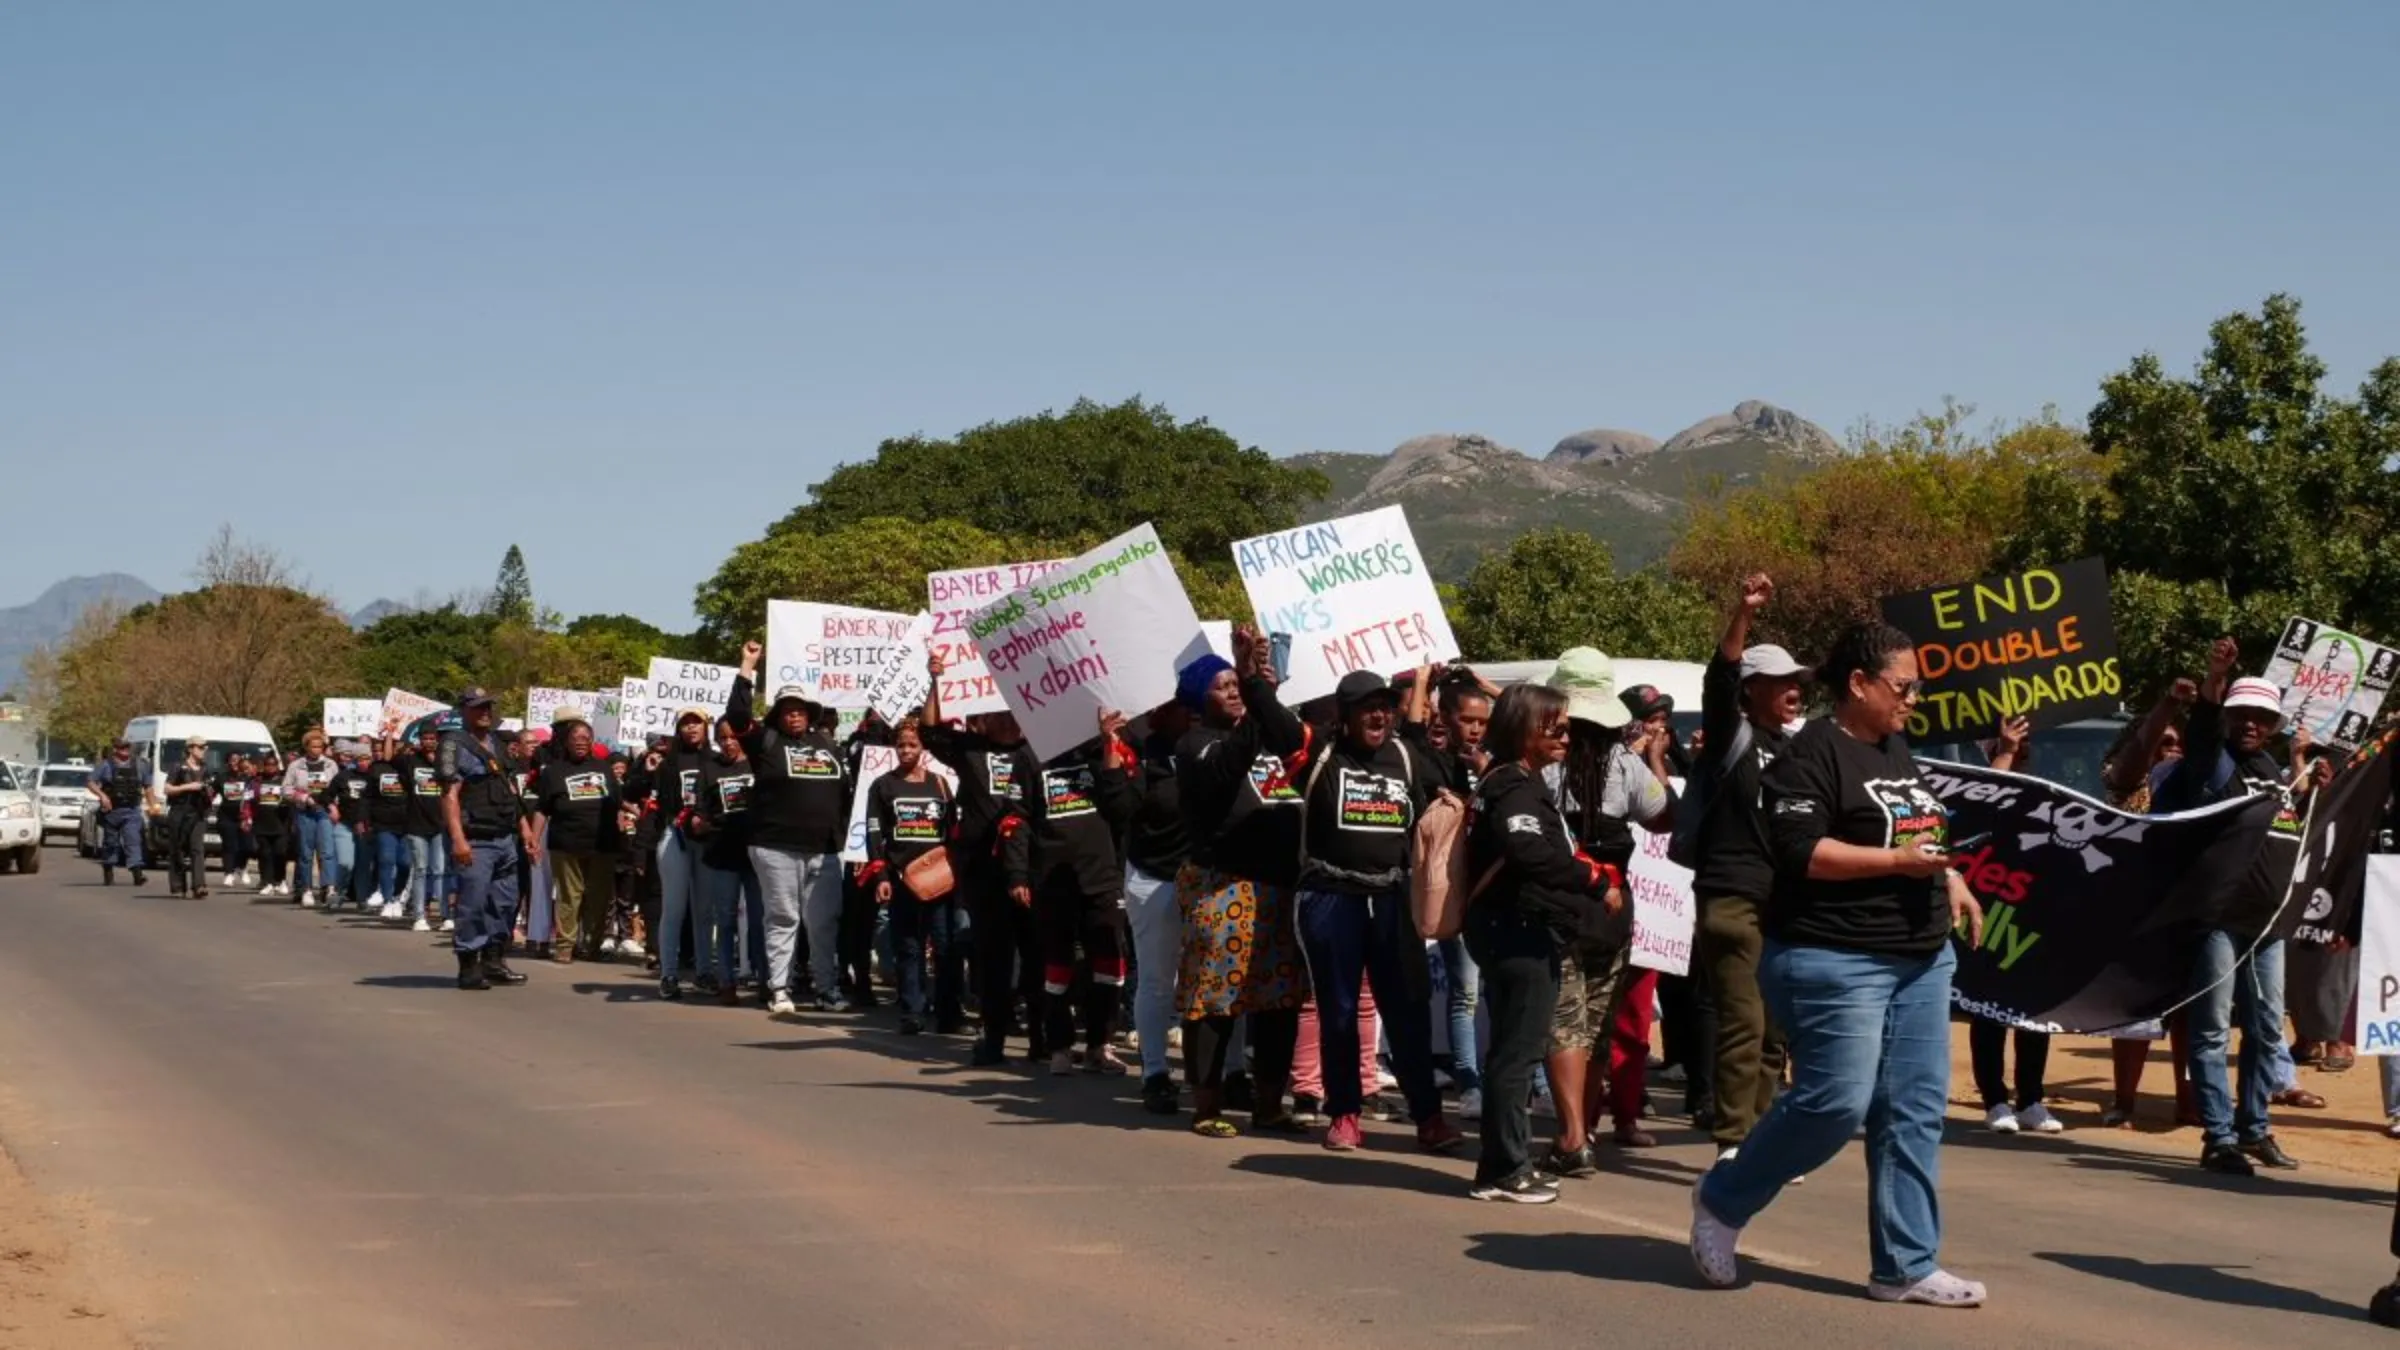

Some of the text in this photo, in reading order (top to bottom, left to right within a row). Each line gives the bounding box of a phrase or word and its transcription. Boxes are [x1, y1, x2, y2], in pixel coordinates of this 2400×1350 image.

[1239, 523, 1343, 579] AFRICAN
[1298, 538, 1413, 595] WORKER'S
[932, 571, 1002, 600] BAYER
[1931, 569, 2061, 630] END
[823, 618, 877, 639] BAYER
[987, 610, 1085, 673] ephindwe
[1260, 600, 1333, 636] LIVES
[823, 647, 895, 667] PESTIC
[1321, 612, 1437, 677] MATTER
[1915, 615, 2083, 680] DOUBLE
[656, 682, 727, 705] DOUBLE
[680, 663, 721, 682] END
[820, 672, 852, 692] ARE
[868, 645, 912, 709] AFRICAN
[1906, 656, 2121, 737] STANDARDS
[2380, 974, 2400, 1014] P
